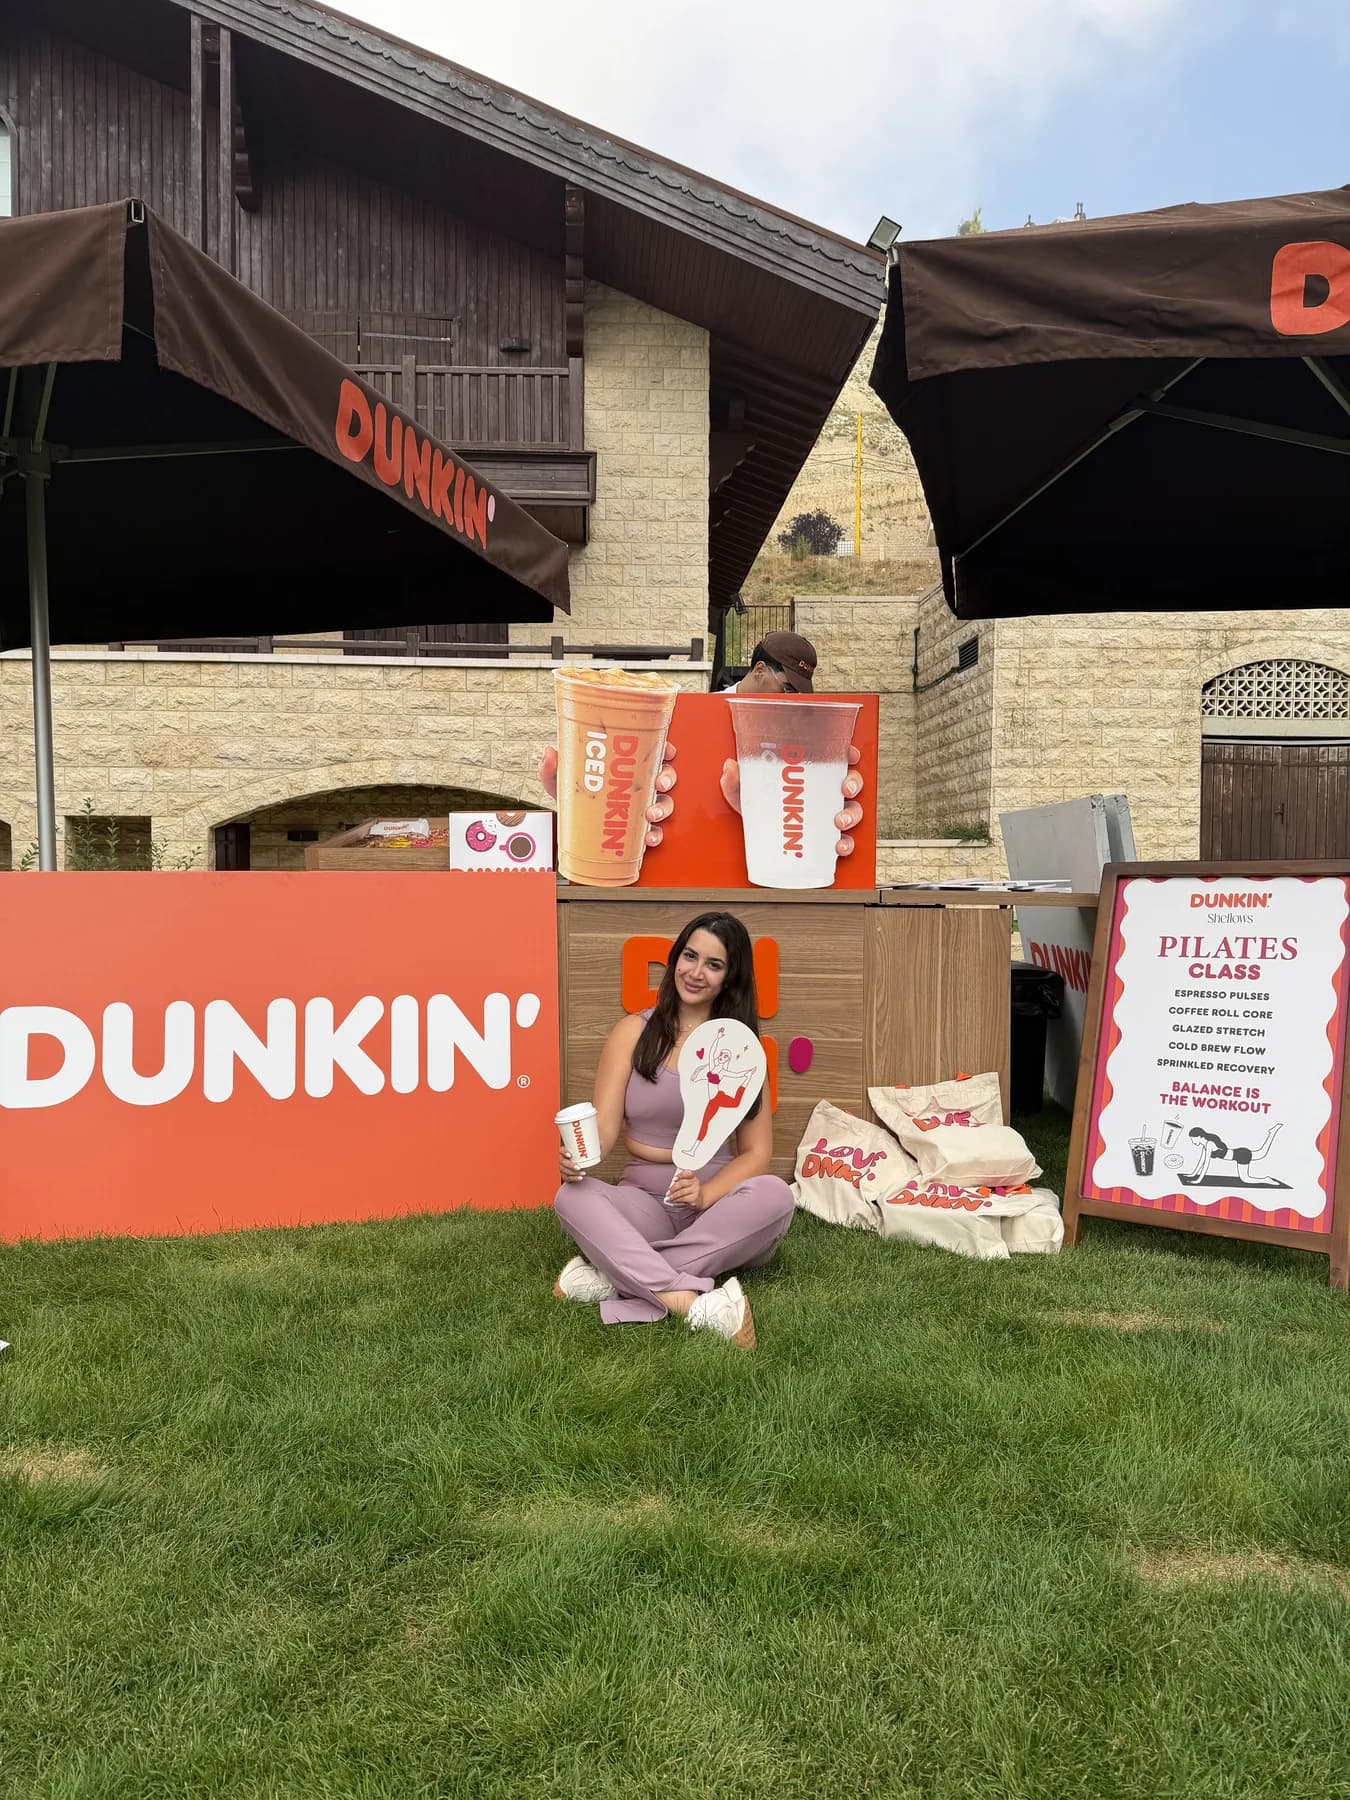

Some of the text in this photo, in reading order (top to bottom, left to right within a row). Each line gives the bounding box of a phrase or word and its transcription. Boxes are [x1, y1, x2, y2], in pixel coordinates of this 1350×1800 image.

[336, 378, 496, 550] DUNKIN'
[584, 731, 608, 792] ICED
[602, 735, 639, 857] DUNKIN'
[781, 744, 805, 859] DUNKIN'
[1190, 893, 1273, 908] DUNKIN'
[1157, 936, 1298, 960] PILATES
[1188, 963, 1261, 980] CLASS
[1175, 990, 1270, 1001] ESPRESSO PULSES
[1168, 1006, 1273, 1019] COFFEE ROLL CORE
[1172, 1024, 1265, 1037] GLAZED STRETCH
[0, 992, 540, 1108] DUNKIN'
[1168, 1041, 1266, 1055] COLD BREW FLOW
[1156, 1058, 1275, 1075] SPRINKLED RECOVERY
[1172, 1081, 1260, 1099] BALANCE IS
[1160, 1093, 1271, 1114] THE WORKOUT
[572, 1120, 588, 1159] DUNKIN'
